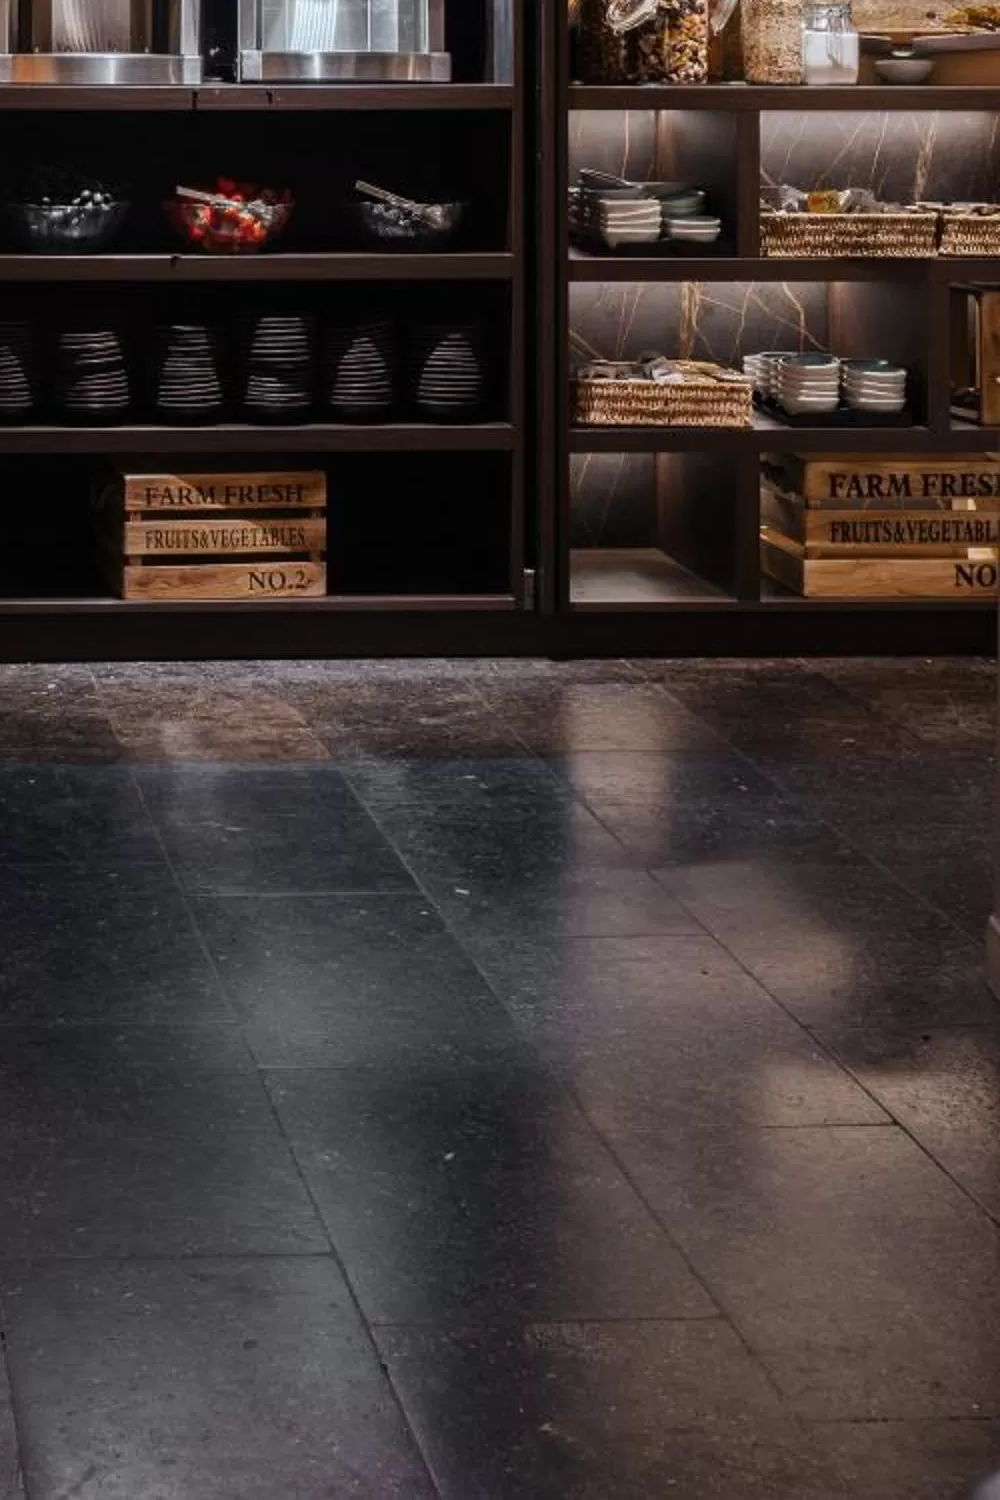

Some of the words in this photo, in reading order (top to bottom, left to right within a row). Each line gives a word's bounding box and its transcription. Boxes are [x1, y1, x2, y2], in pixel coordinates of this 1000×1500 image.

[144, 485, 216, 507] FARM
[223, 482, 303, 504] FRESH
[828, 473, 912, 498] FARM
[831, 519, 1000, 544] FRUITS&VEGETABL
